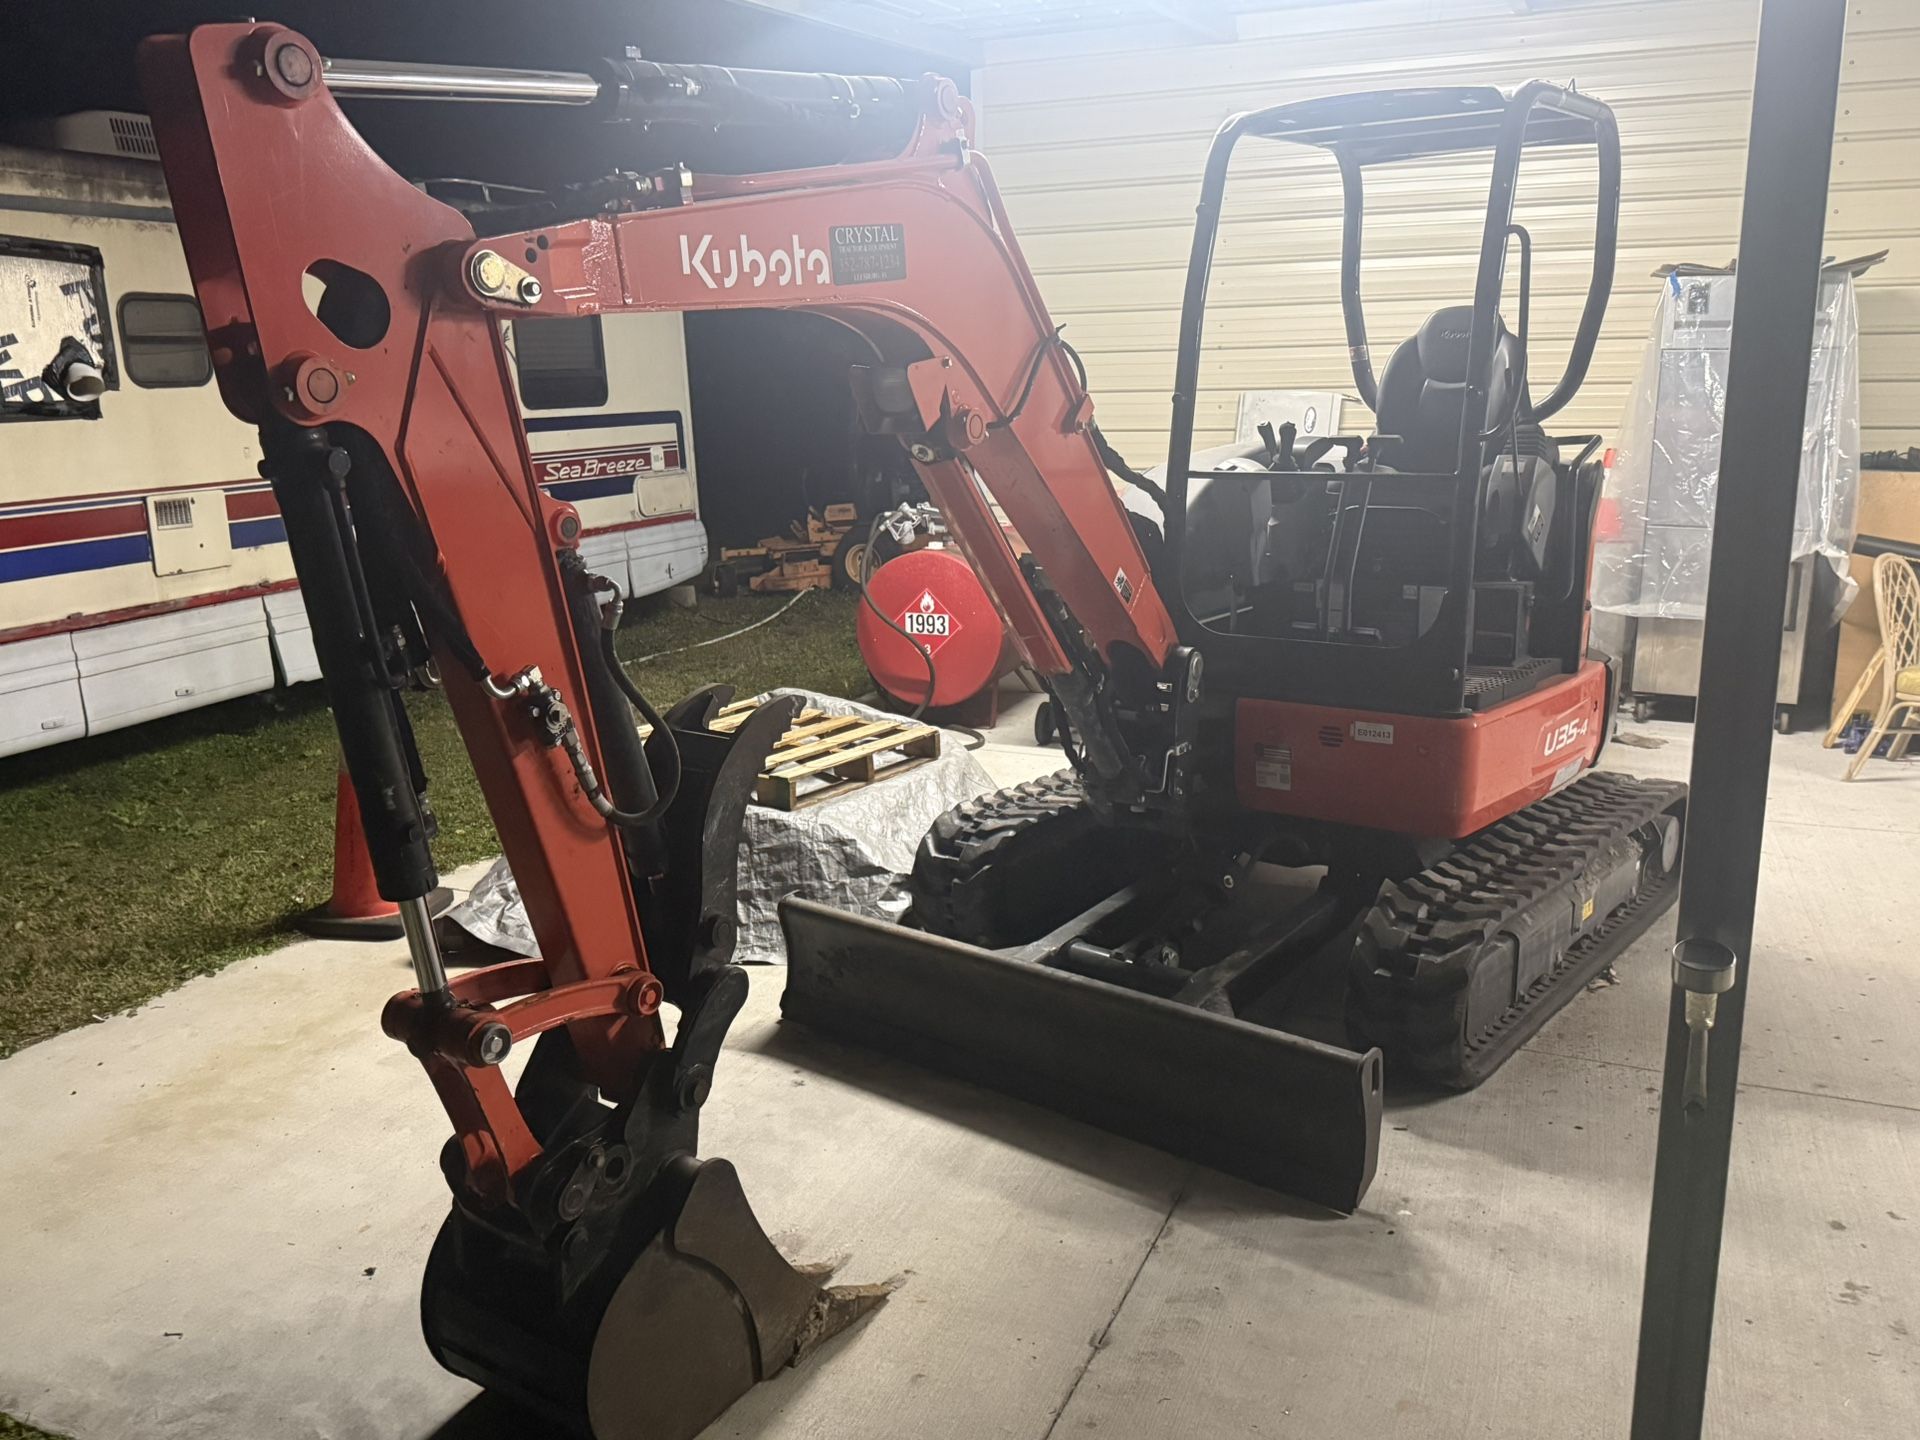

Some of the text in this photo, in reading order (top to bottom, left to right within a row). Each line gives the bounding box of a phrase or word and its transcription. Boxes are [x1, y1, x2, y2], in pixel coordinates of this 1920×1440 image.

[835, 225, 898, 245] CRYSTAL
[680, 234, 830, 289] Kubota
[908, 614, 946, 635] 1993
[924, 643, 932, 655] 3
[1543, 718, 1589, 757] U35-4
